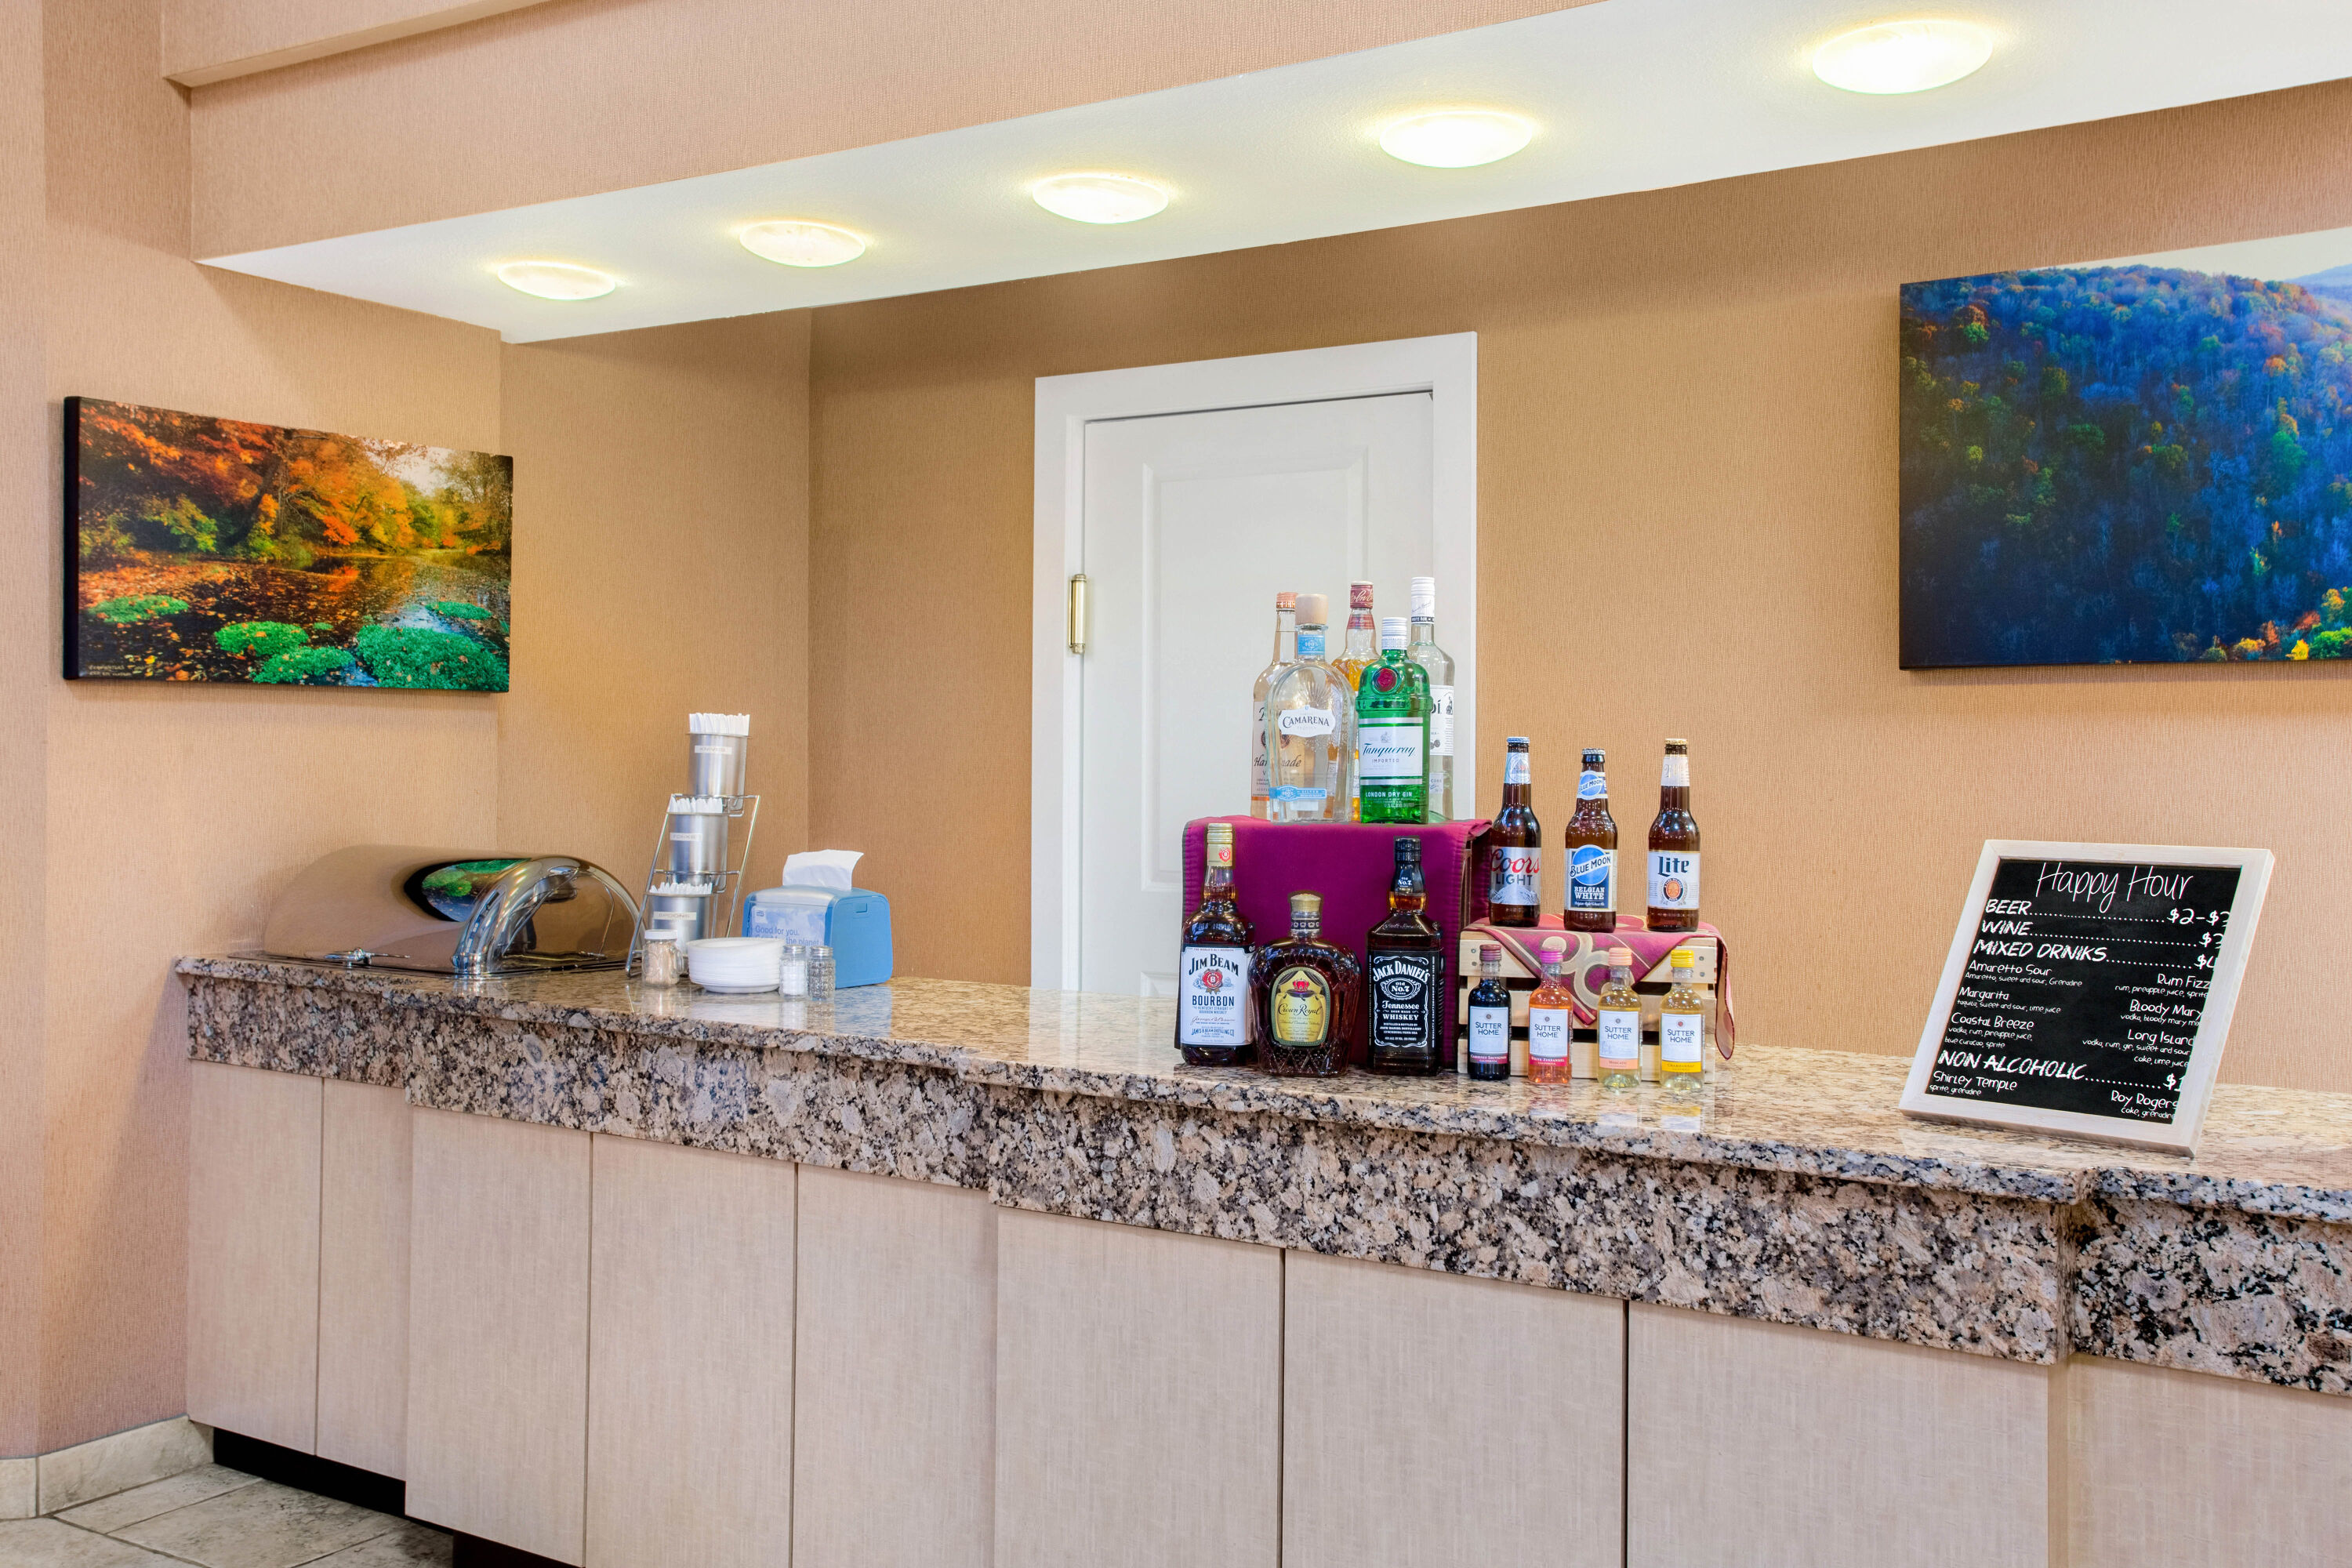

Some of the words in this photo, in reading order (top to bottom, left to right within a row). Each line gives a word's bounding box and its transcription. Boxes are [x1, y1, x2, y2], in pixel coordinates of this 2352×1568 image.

[1283, 716, 1329, 728] CAMARENA
[1363, 742, 1415, 757] Tanqueray
[1490, 849, 1540, 873] Coors
[1570, 863, 1589, 877] BLUE
[1591, 856, 1611, 869] MOON
[1657, 856, 1690, 877] Lite
[1496, 873, 1533, 885] LIGHT
[2036, 862, 2118, 913] Happy
[2127, 866, 2194, 902] Hour
[755, 925, 773, 934] Good
[1973, 939, 2034, 957] MIXED
[1189, 956, 1207, 975] JIM
[1210, 953, 1240, 977] BEAM
[1373, 964, 1395, 982] JACK
[1395, 960, 1431, 984] DANIEL'S
[1969, 960, 2023, 974] Amaretto
[2026, 964, 2052, 976] Sour
[2158, 973, 2183, 988] Rum
[2186, 975, 2211, 989] Fizz
[1959, 986, 2009, 1002] Margarita
[2114, 985, 2131, 993] rum,
[2132, 985, 2165, 995] pineapple
[2165, 989, 2185, 998] juice,
[1192, 995, 1235, 1007] BOURBON
[1381, 1000, 1420, 1010] Tennessee
[1278, 1004, 1298, 1015] Crown
[1294, 1004, 1323, 1017] Royal
[2129, 999, 2169, 1018] Bloody
[2172, 1004, 2203, 1020] Mary
[1951, 1012, 1991, 1027] Coastal
[1994, 1015, 2034, 1030] Breeze
[2143, 1014, 2166, 1025] bloody
[2168, 1018, 2187, 1028] mary
[1604, 1025, 1632, 1034] SUTTER
[1667, 1029, 1694, 1037] SUTTER
[1984, 1029, 2016, 1040] pineapple
[2128, 1029, 2158, 1046] Long
[1986, 1041, 2005, 1050] sprite
[2105, 1042, 2121, 1051] rum,
[1937, 1049, 1982, 1069] NON
[1983, 1054, 2087, 1080] ALCOHOLIC
[2133, 1055, 2153, 1065] coke,
[1933, 1070, 1973, 1089] Shirley
[1976, 1076, 2018, 1093] Temple
[1929, 1084, 1950, 1094] sprite,
[1951, 1087, 1982, 1096] grenadine
[2111, 1090, 2133, 1107] Roy
[2121, 1107, 2141, 1117] coke,
[2141, 1110, 2174, 1119] grenadin
